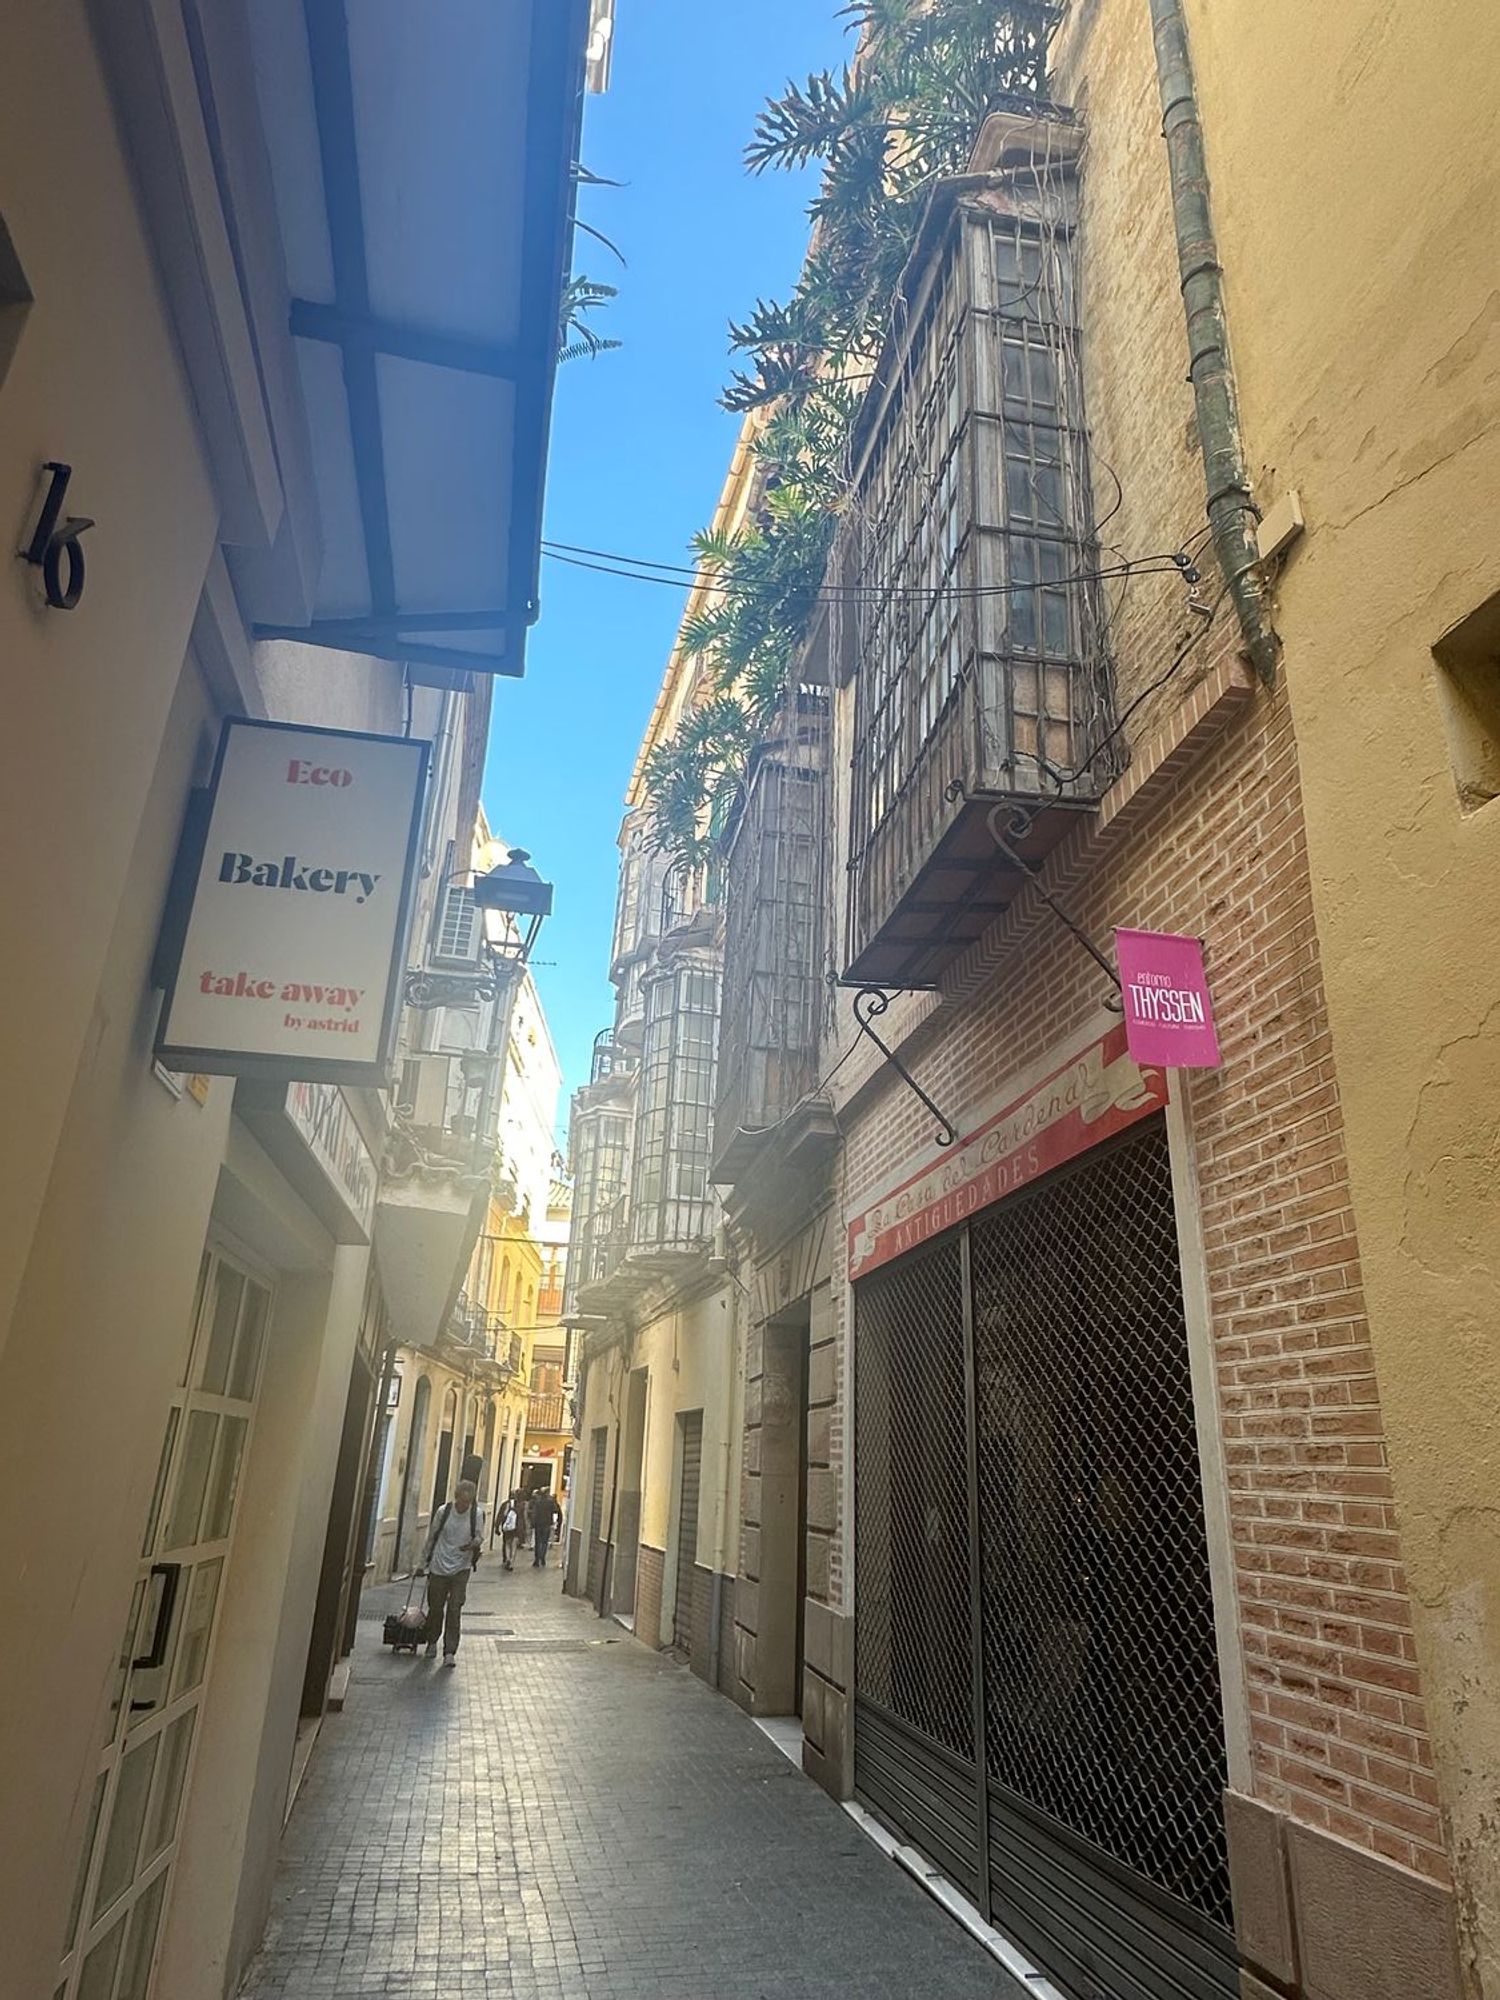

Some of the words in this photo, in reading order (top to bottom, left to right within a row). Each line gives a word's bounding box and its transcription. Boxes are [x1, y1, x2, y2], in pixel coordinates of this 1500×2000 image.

[15, 462, 95, 610] 16
[285, 759, 354, 788] Eco
[218, 851, 383, 905] Bakery
[199, 970, 276, 1000] take
[280, 983, 366, 1012] away
[1137, 971, 1172, 988] entorno
[283, 1012, 305, 1031] by
[307, 1016, 360, 1034] astrid
[1128, 984, 1205, 1023] THYSSEN
[942, 1157, 972, 1192] del
[978, 1063, 1095, 1164] Cardenal
